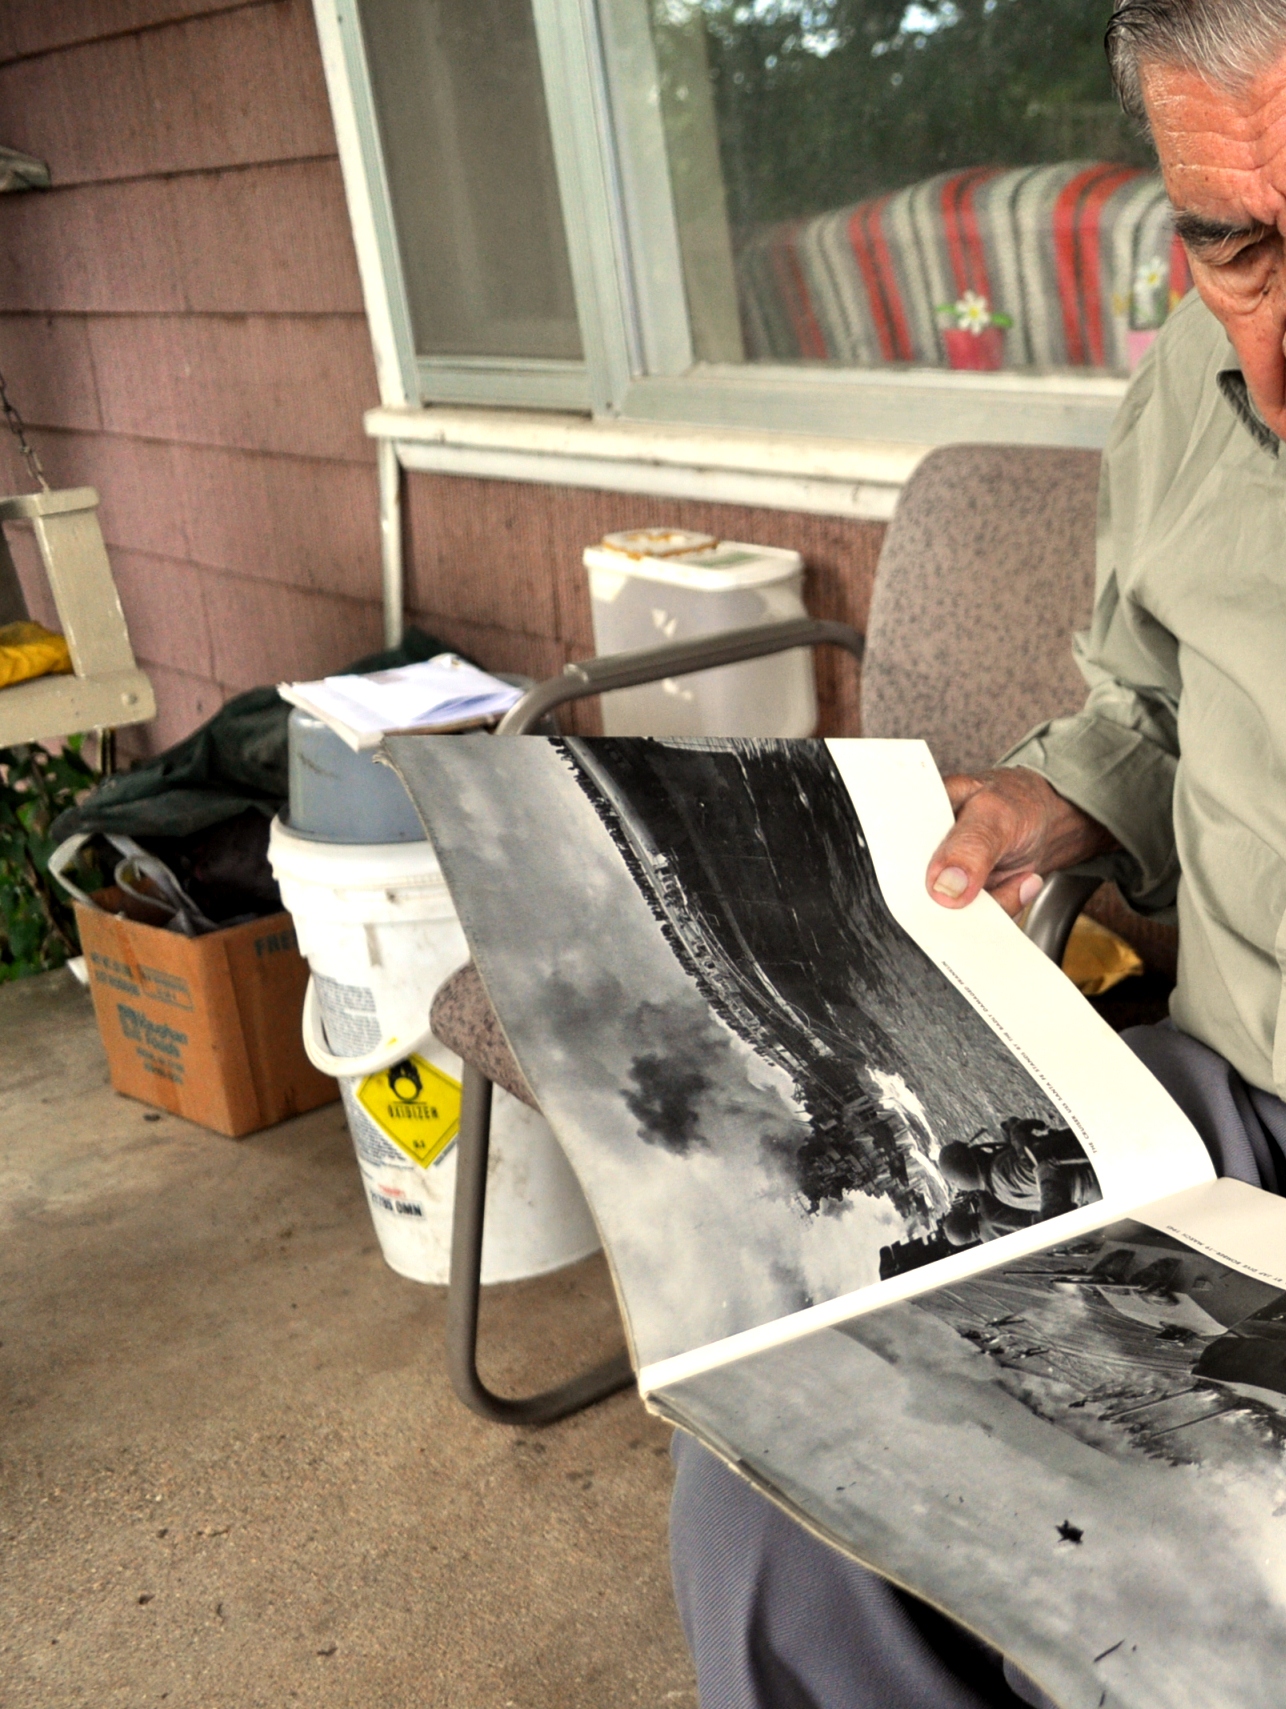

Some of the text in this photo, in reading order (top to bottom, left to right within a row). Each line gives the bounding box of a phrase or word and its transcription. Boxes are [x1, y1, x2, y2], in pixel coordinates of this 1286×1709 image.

[941, 961, 964, 985] FRANKLIN
[964, 986, 988, 1012] DAMAGED
[988, 1014, 1004, 1030] BADLY
[1003, 1032, 1013, 1042] THE
[1021, 1052, 1040, 1072] STANDS
[1046, 1082, 1063, 1101] SANTA
[388, 1105, 439, 1119] OXIDIZER
[1062, 1103, 1072, 1113] USS
[1071, 1115, 1089, 1139] CRUISER
[1088, 1142, 1097, 1153] THE
[1182, 1233, 1205, 1246] MARCH
[1242, 1265, 1258, 1273] DIVE
